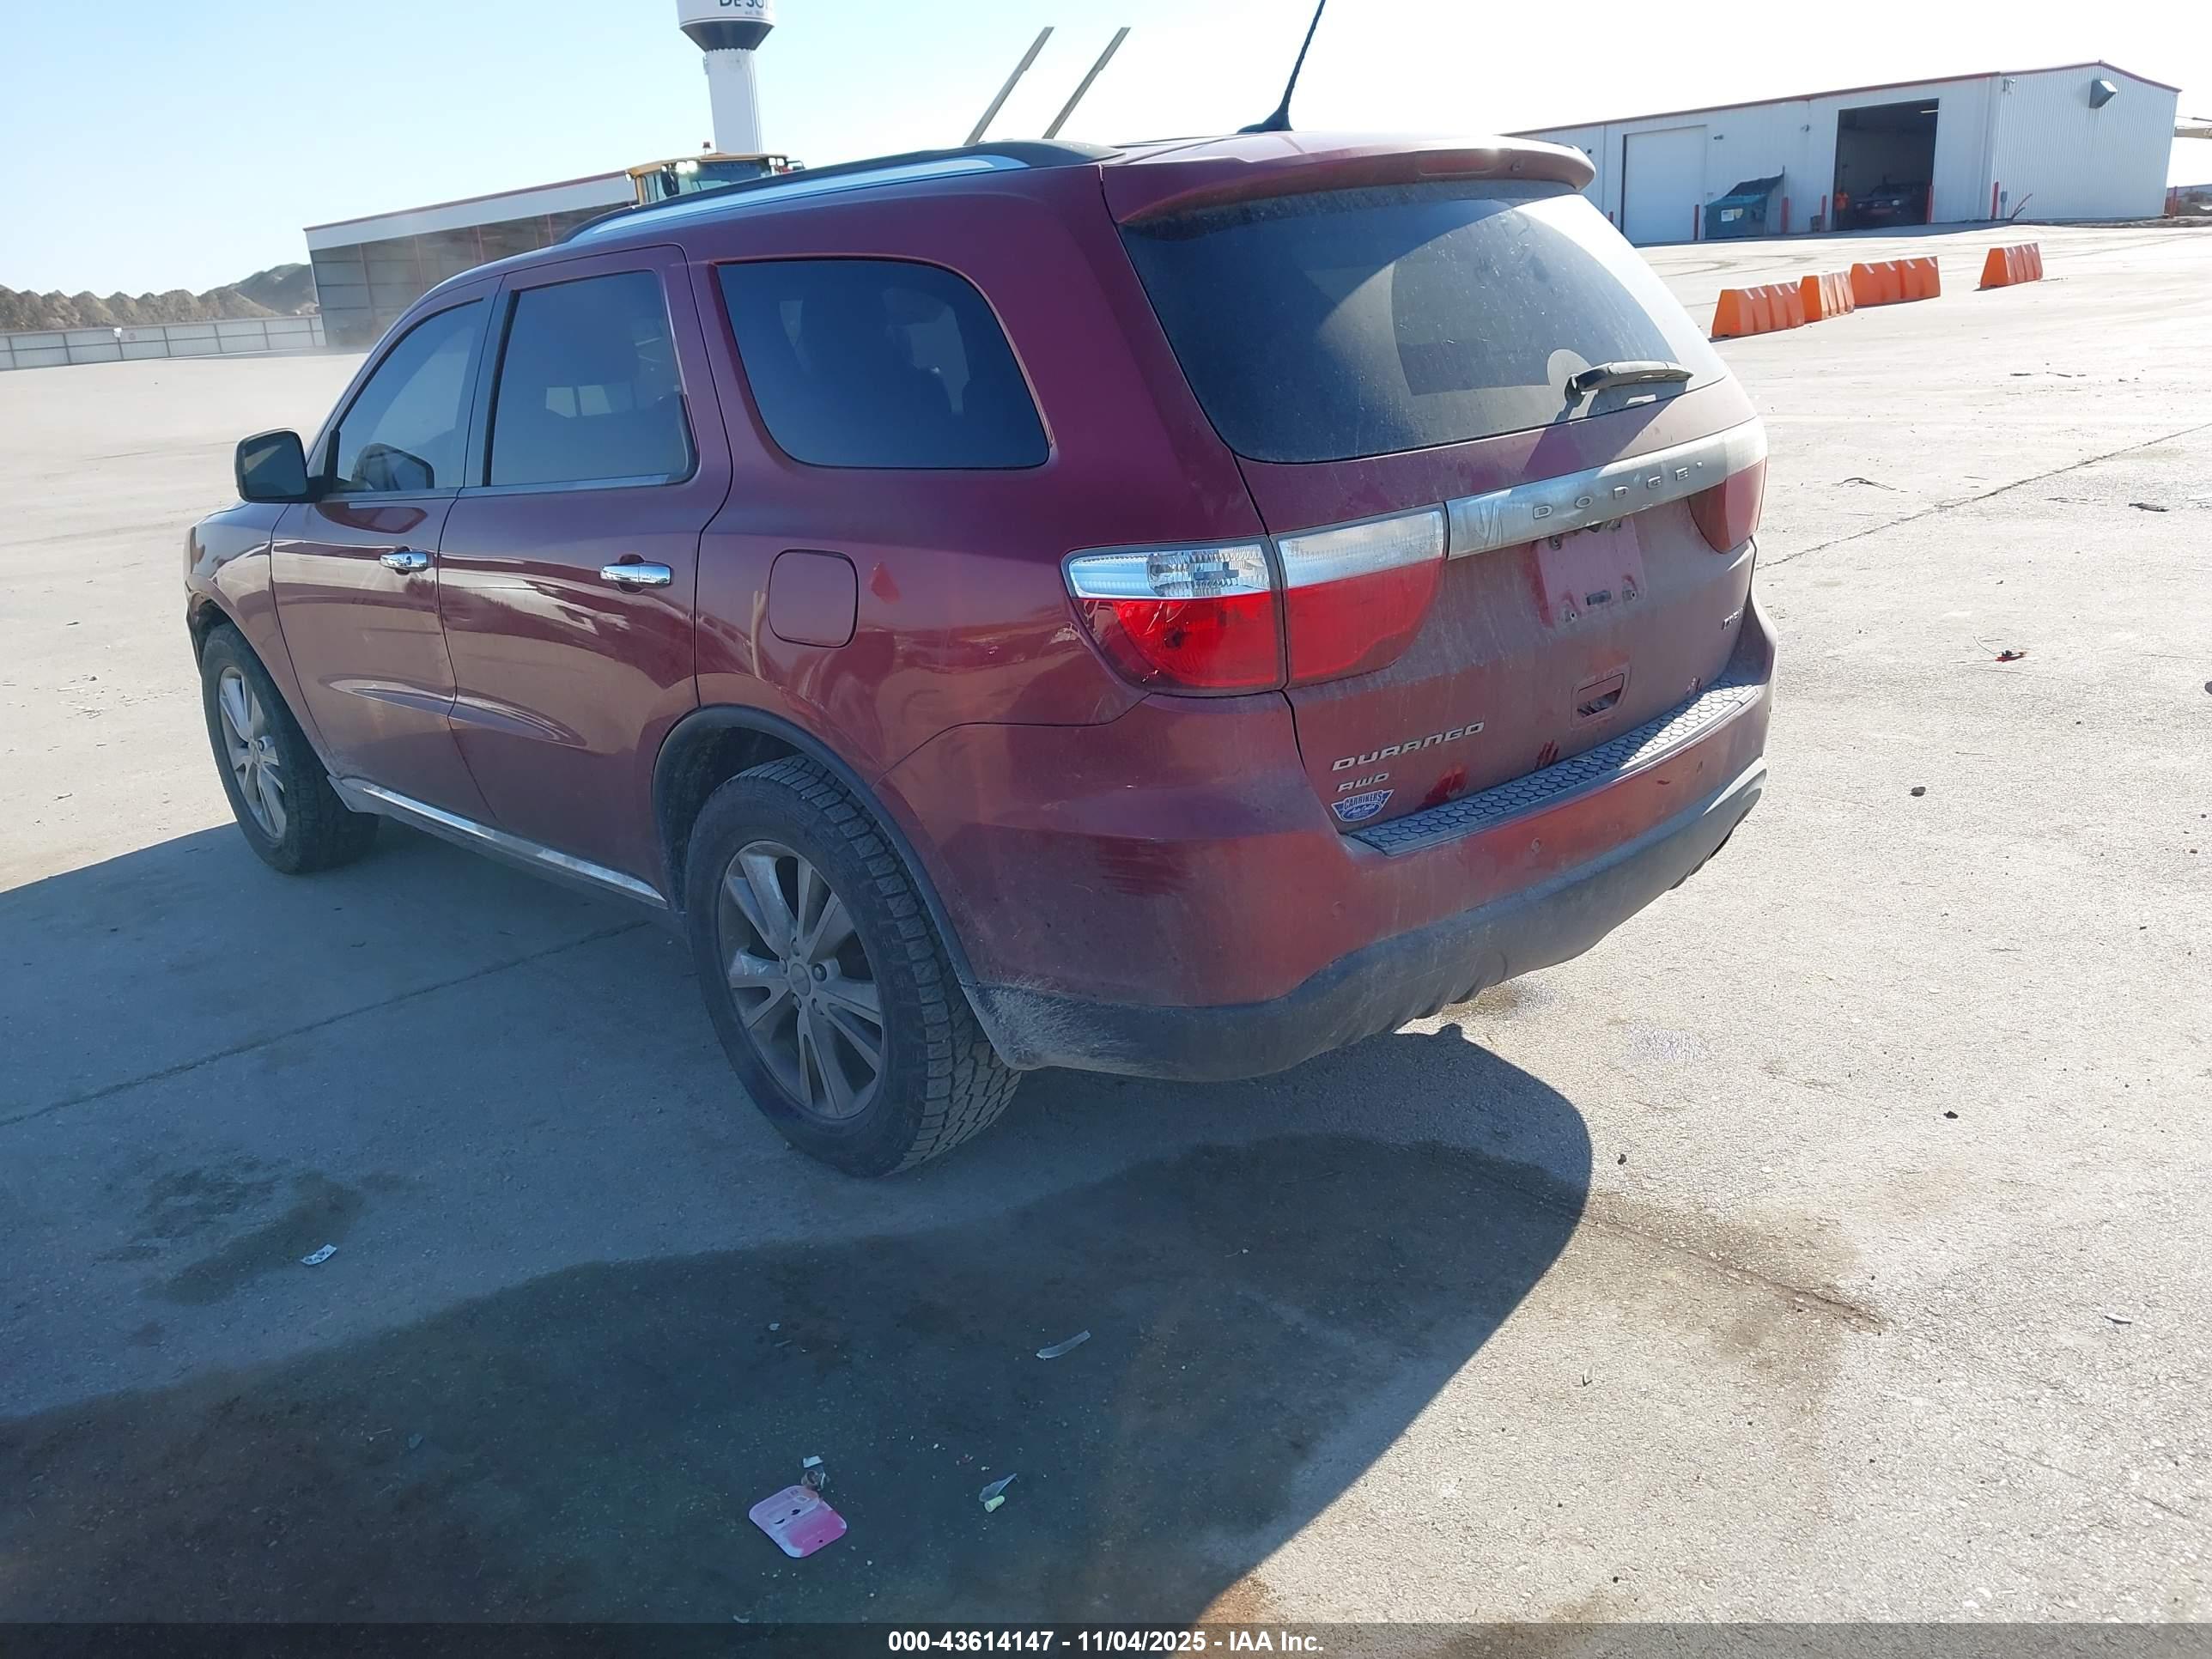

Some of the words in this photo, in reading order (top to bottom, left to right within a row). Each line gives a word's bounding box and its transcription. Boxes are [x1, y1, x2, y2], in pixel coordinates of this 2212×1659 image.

[1533, 466, 1689, 520] DODGE
[1332, 721, 1485, 771] DURANGO
[1337, 772, 1390, 793] AWD
